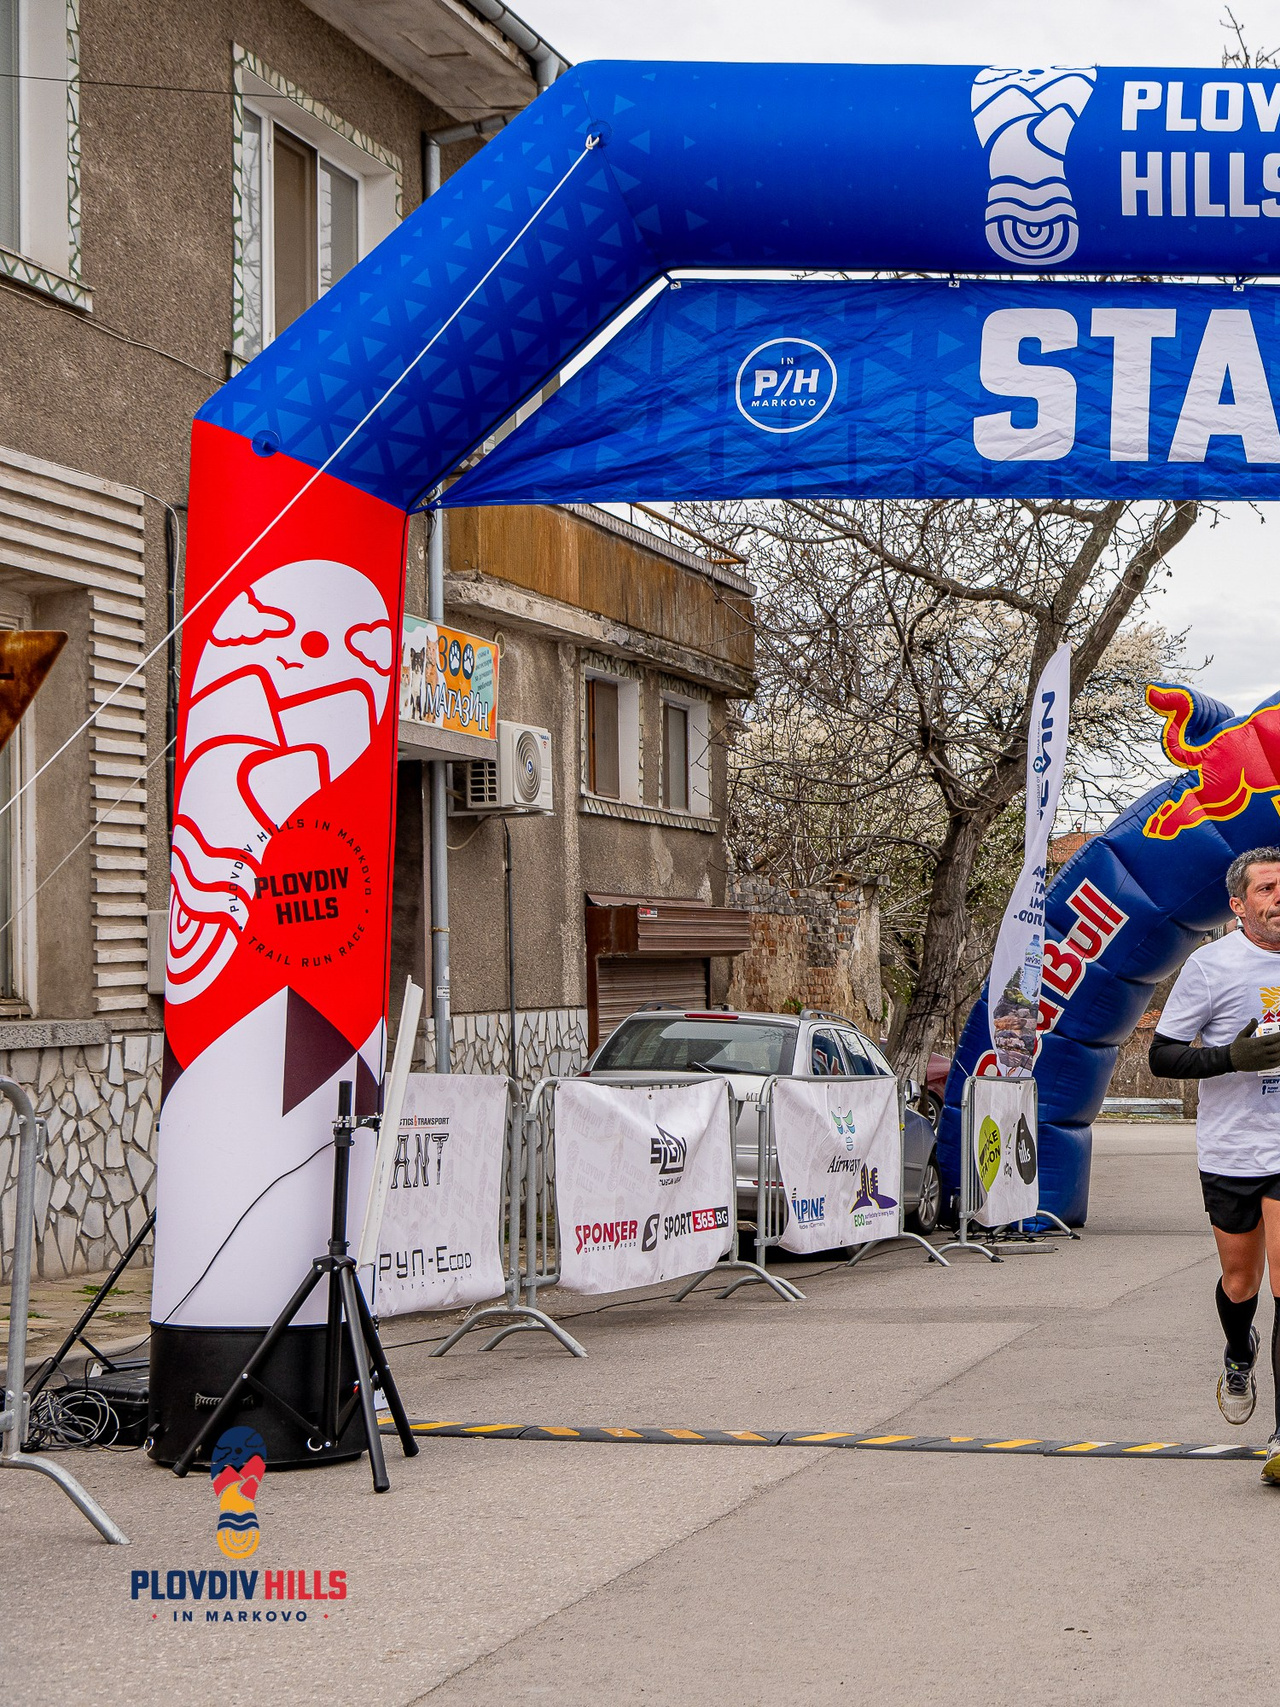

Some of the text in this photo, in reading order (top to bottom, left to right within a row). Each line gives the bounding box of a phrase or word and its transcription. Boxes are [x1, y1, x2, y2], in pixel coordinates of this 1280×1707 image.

[780, 357, 795, 365] IN
[753, 369, 820, 397] P/H
[751, 399, 817, 407] MARKOVO
[425, 682, 489, 732] МАГАЗИН
[228, 818, 372, 914] PLOVDIV HILLS IN MARKOVO
[253, 866, 350, 900] PLOVDIV
[275, 896, 339, 926] HILLS
[248, 922, 365, 968] TRAIL RUN RACE
[1042, 881, 1126, 997] Bull
[417, 1116, 450, 1126] TRANSPORT
[575, 1219, 638, 1255] SPONSER
